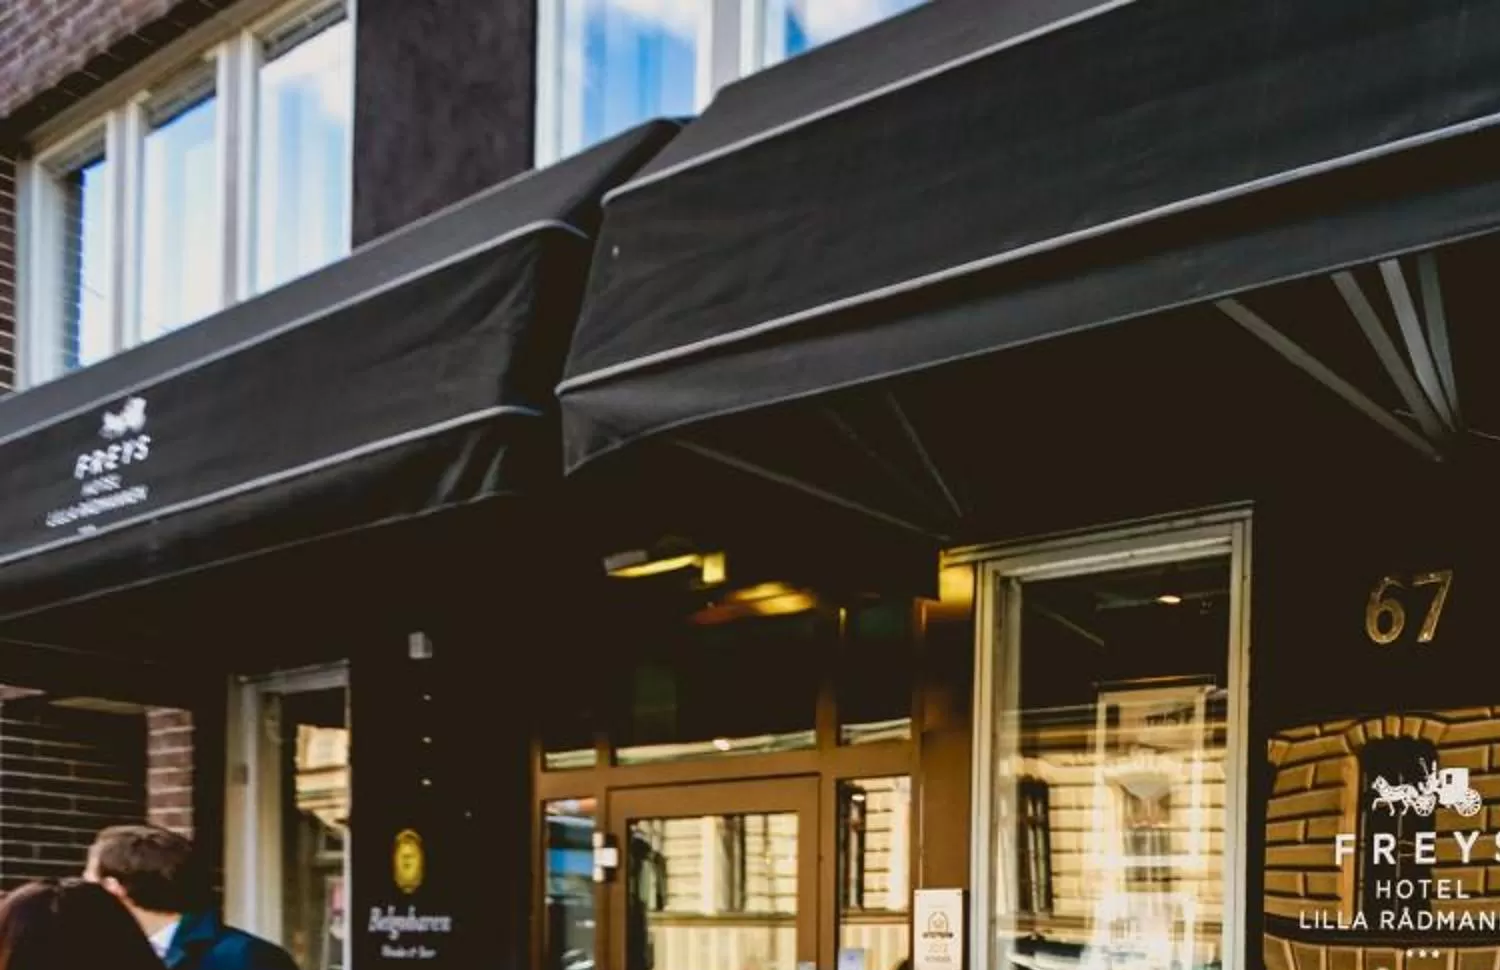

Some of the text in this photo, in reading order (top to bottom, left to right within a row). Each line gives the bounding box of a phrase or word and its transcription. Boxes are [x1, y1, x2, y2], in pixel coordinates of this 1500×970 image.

[1365, 569, 1453, 645] 67
[1375, 879, 1470, 900] HOTEL
[1299, 911, 1369, 931] LILLA
